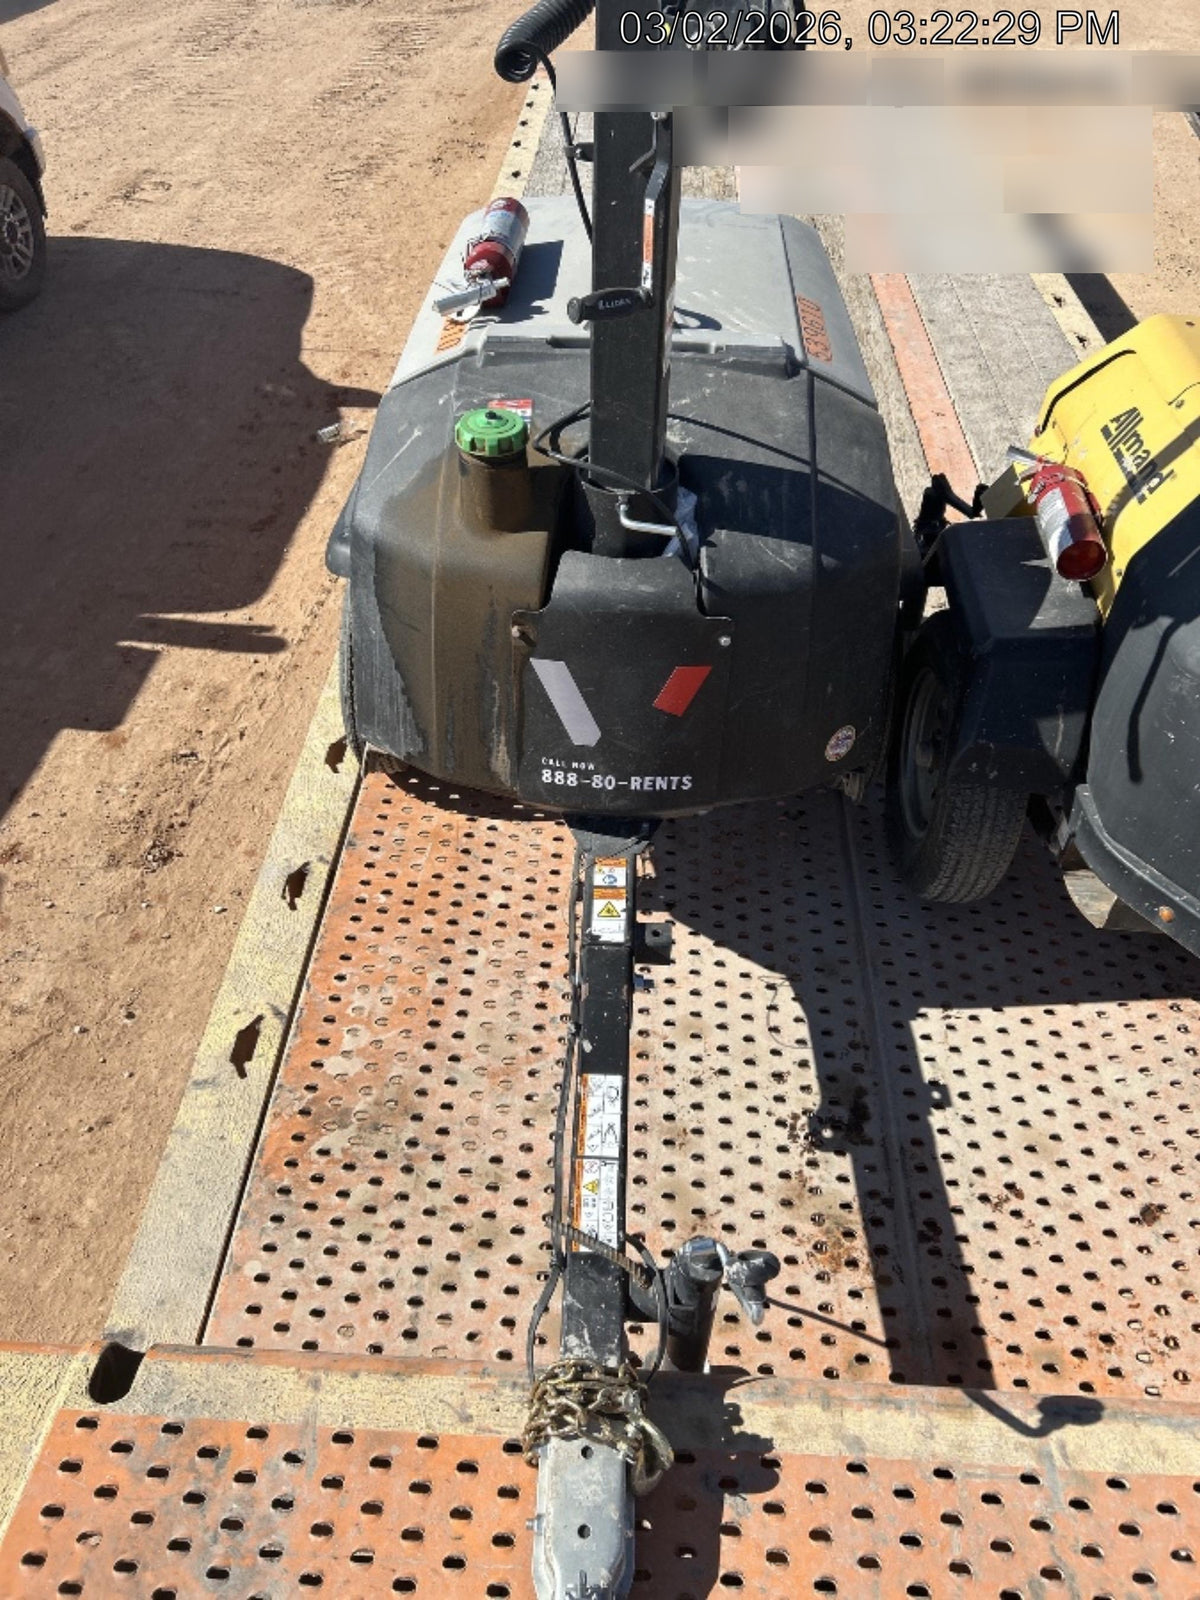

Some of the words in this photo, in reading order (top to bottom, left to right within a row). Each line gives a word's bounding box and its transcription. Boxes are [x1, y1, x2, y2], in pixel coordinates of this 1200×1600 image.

[1104, 406, 1175, 499] Allmand
[541, 756, 568, 769] CALL
[572, 761, 595, 771] NOW
[541, 769, 693, 791] 888-80-RENTS
